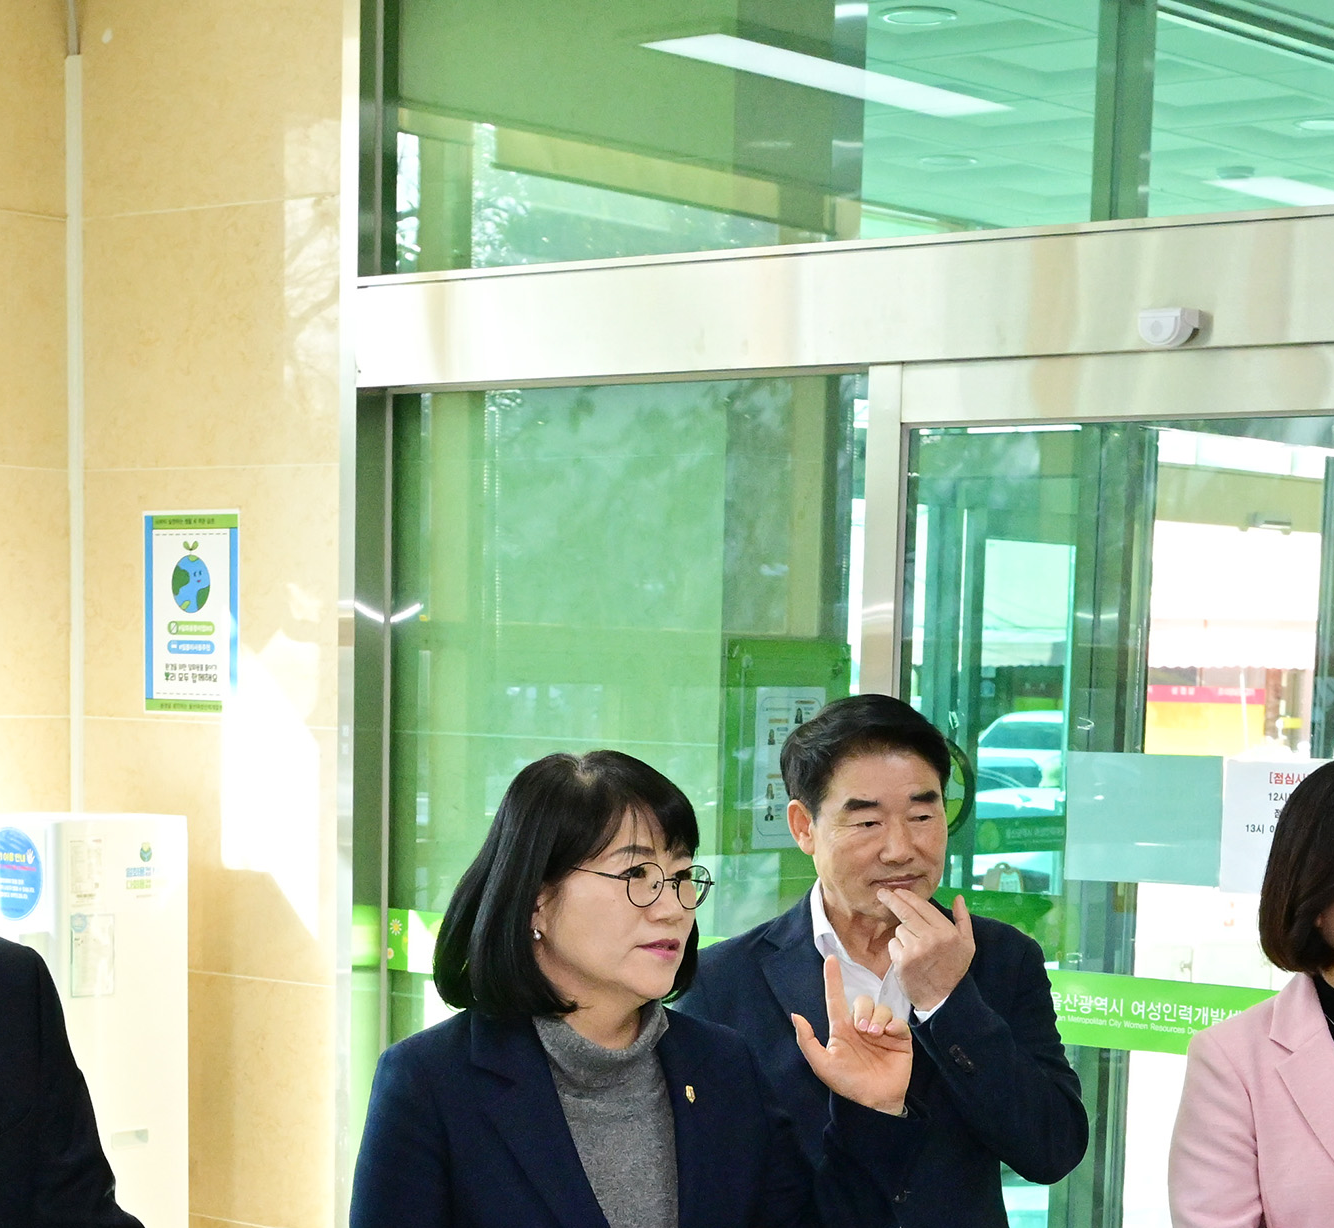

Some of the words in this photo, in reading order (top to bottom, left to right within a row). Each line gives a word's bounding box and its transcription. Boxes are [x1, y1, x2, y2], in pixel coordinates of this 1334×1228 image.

[1269, 771, 1308, 785] [점심시
[1245, 824, 1264, 834] 13시
[1051, 992, 1124, 1018] 울산광역시
[1068, 1015, 1107, 1027] Metropolitan
[1109, 1018, 1121, 1029] City
[1123, 1019, 1148, 1030] Women
[1150, 1022, 1185, 1034] Resources
